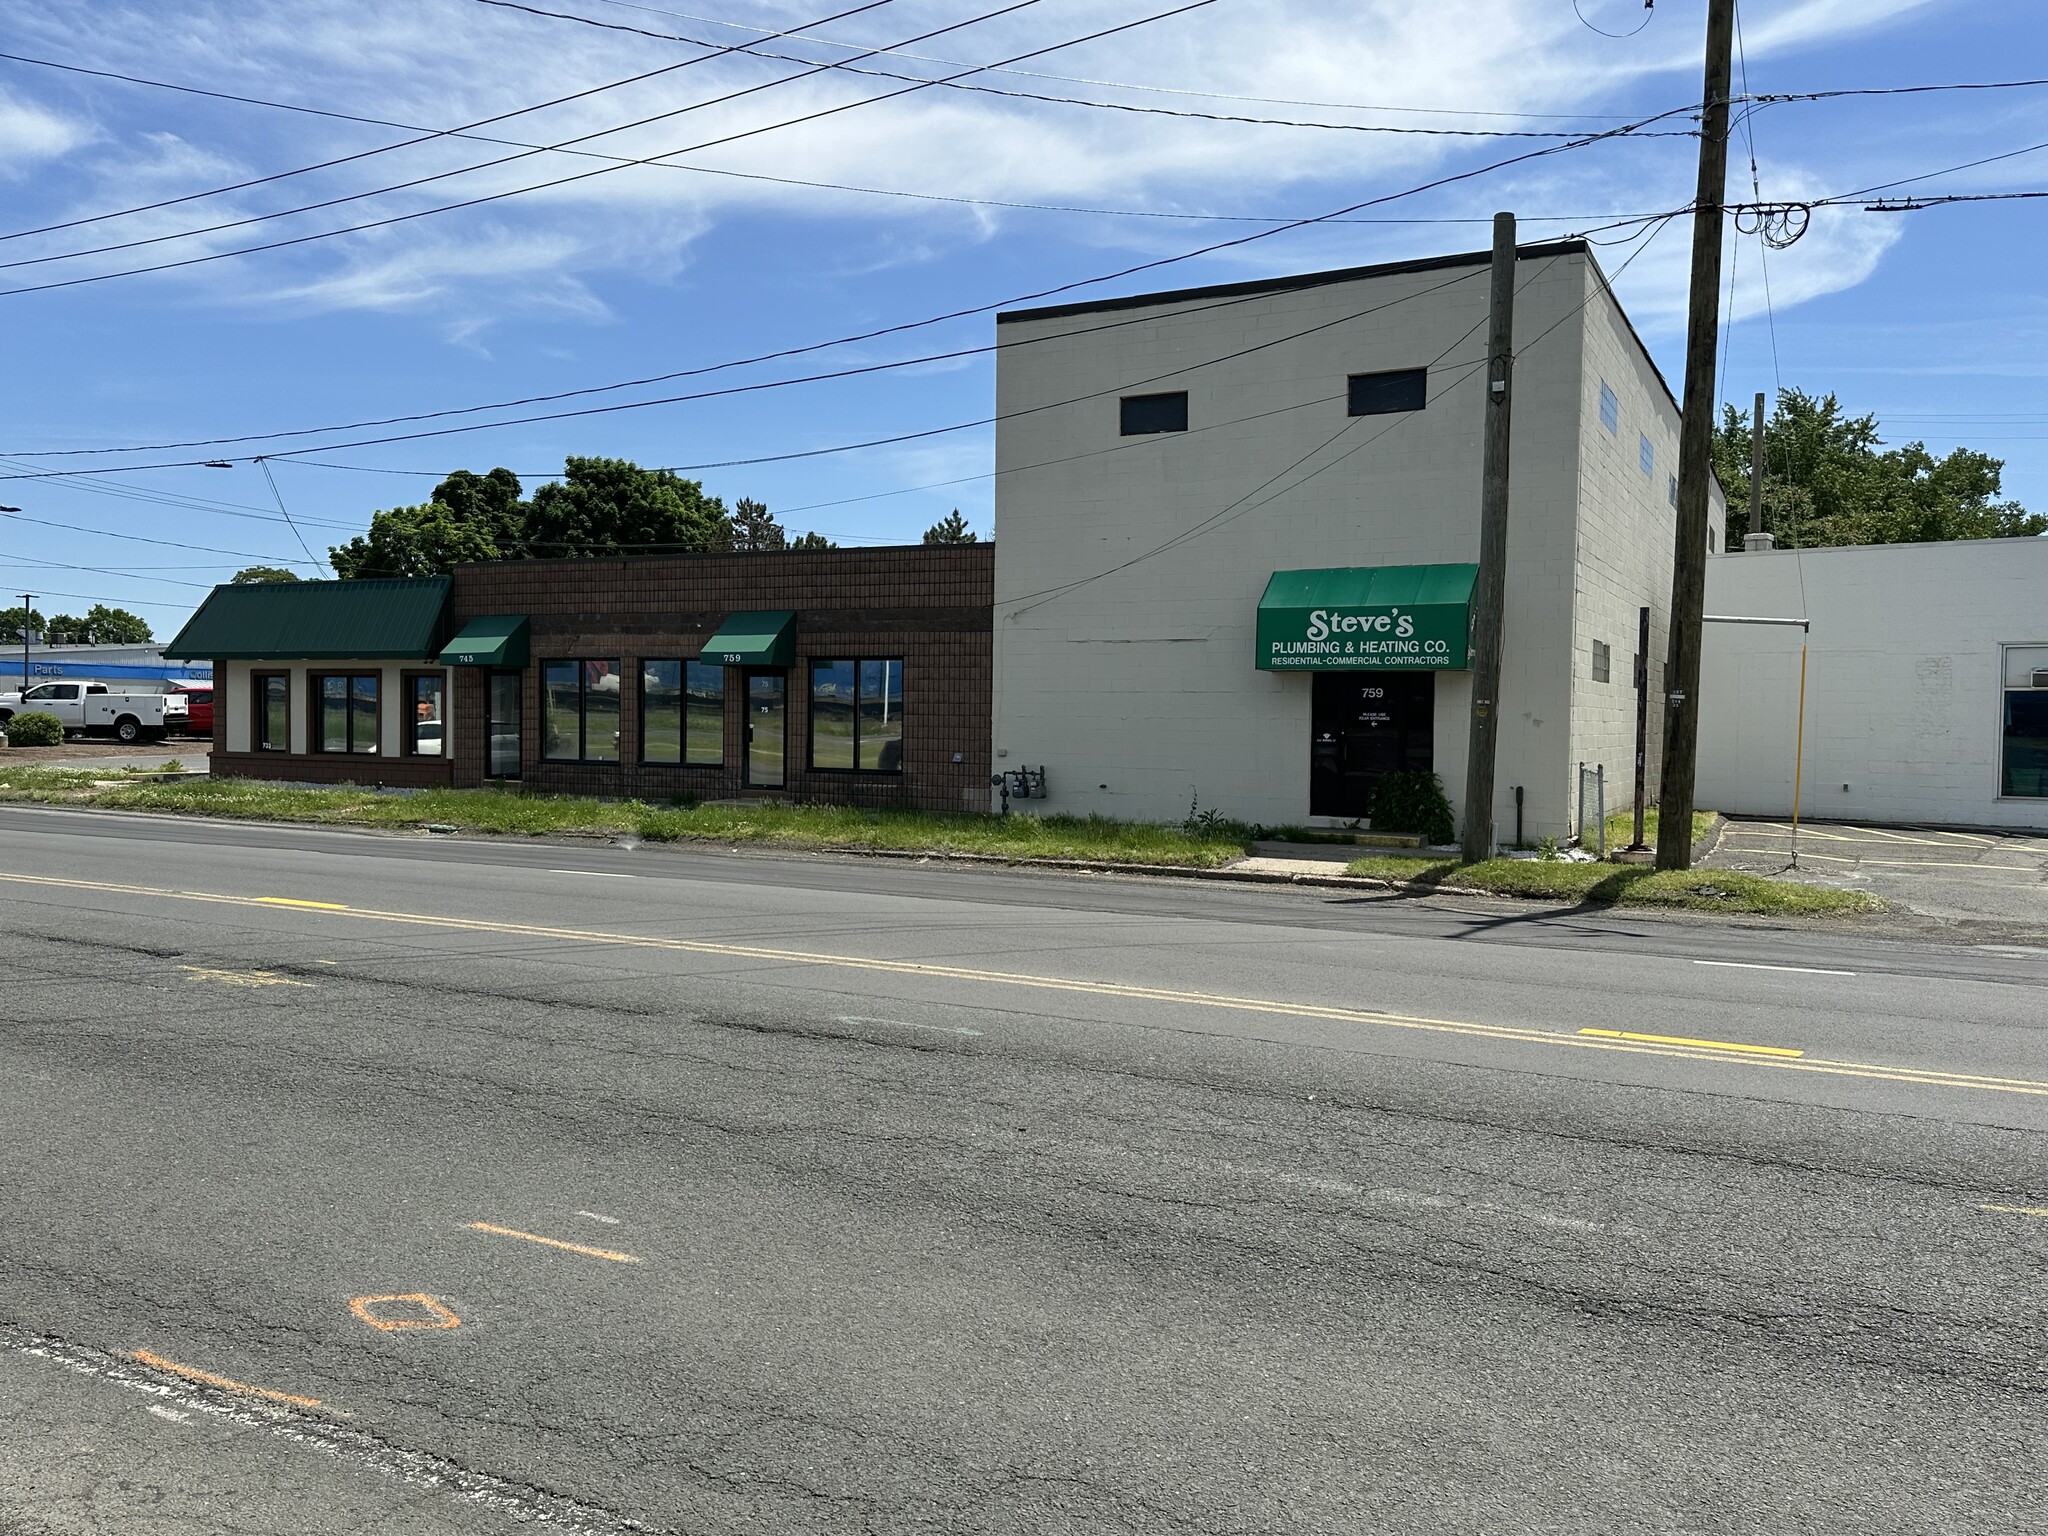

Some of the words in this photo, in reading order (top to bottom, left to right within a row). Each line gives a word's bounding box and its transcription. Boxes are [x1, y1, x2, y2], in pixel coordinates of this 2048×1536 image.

[1306, 608, 1414, 642] Steve's
[1272, 641, 1340, 654] PLUMBING
[1344, 642, 1355, 653] &
[1359, 641, 1420, 653] HEATING
[1424, 640, 1450, 653] CO.
[459, 655, 474, 663] 745
[723, 653, 741, 662] 759
[1271, 656, 1382, 665] RESIDENTIAL-COMMERCIAL
[1384, 656, 1450, 665] CONTRACTORS
[34, 664, 64, 676] Parts
[1361, 687, 1384, 698] 759
